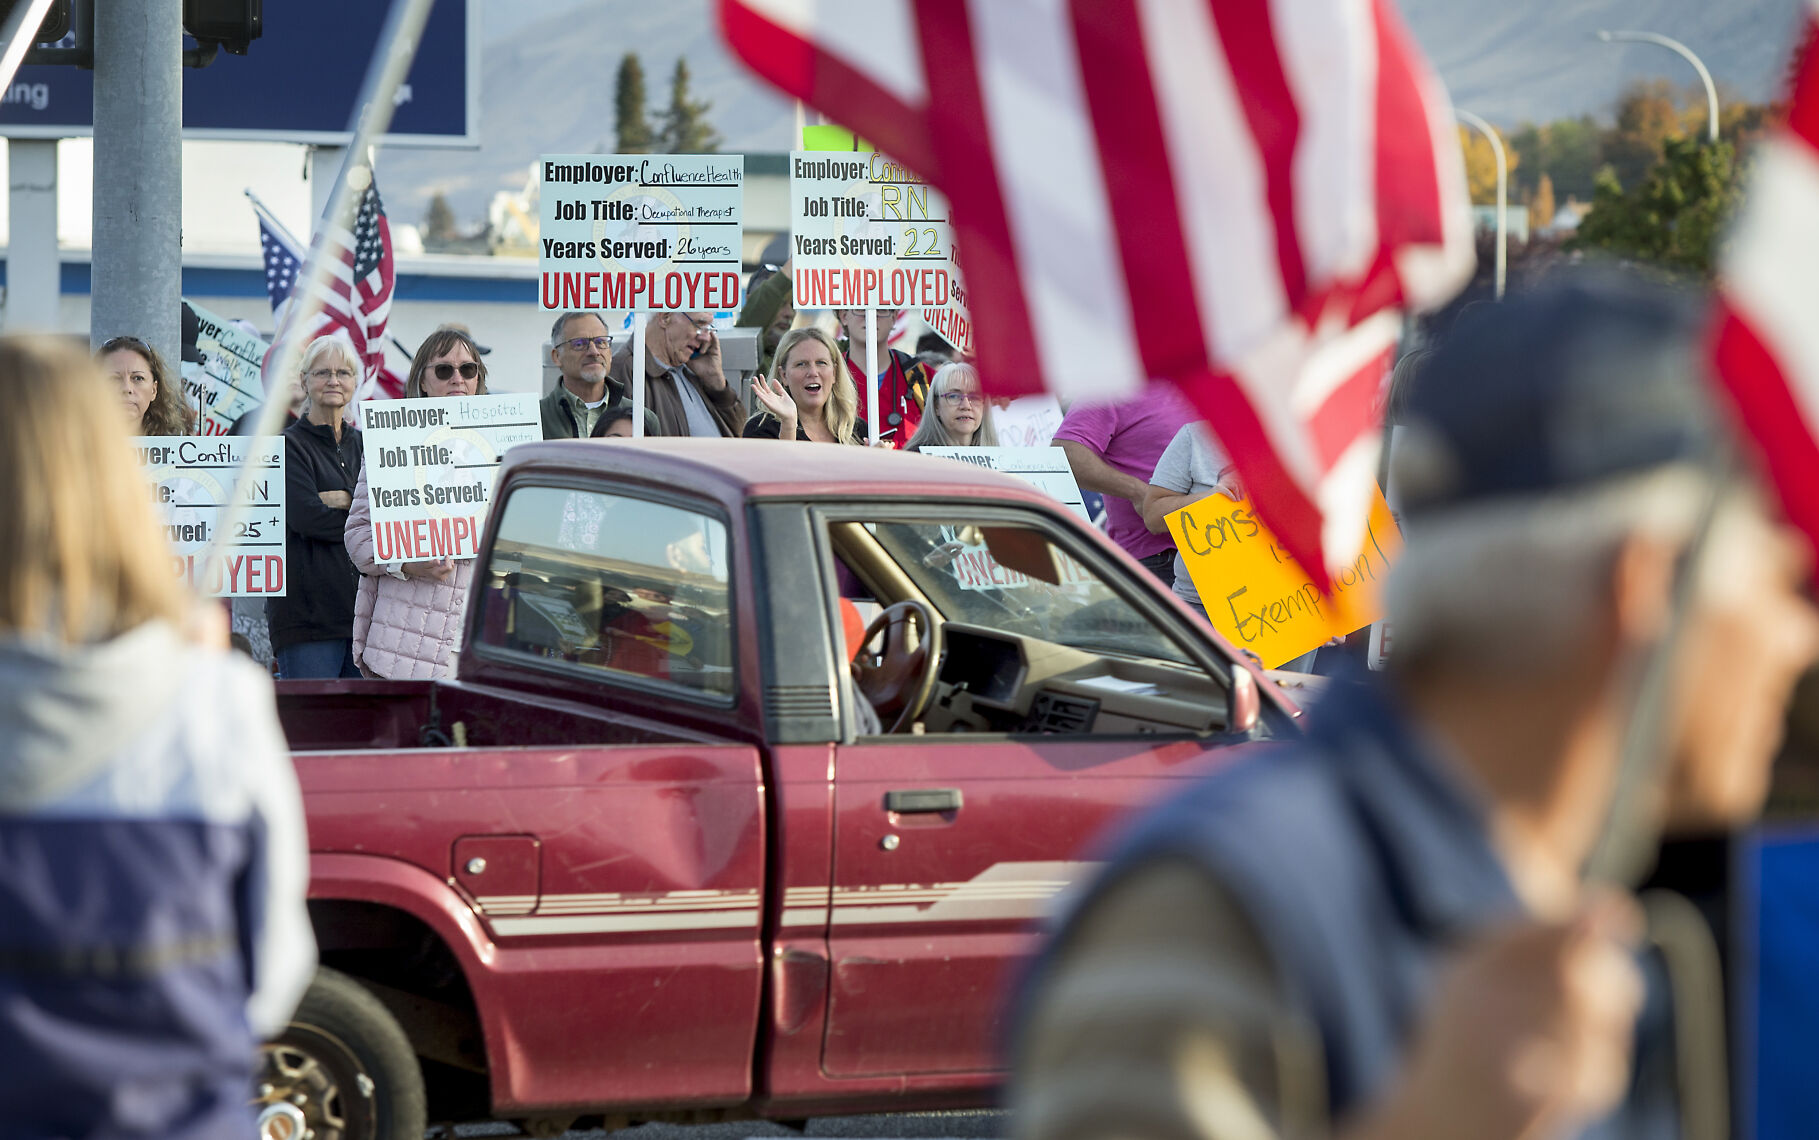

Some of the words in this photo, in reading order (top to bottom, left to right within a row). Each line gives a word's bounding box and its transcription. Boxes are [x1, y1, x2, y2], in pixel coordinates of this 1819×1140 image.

[545, 161, 639, 185] Employer:
[794, 158, 869, 181] Employer:
[554, 200, 587, 221] Job
[591, 200, 639, 221] Title:
[642, 203, 694, 221] Occupational
[697, 206, 735, 219] Therapist
[803, 196, 829, 217] Job
[831, 197, 869, 218] Title:
[881, 185, 929, 220] RN
[542, 238, 596, 259] Years
[600, 238, 672, 259] Served:
[794, 235, 837, 255] Years
[840, 235, 897, 256] Served:
[904, 228, 941, 256] 22
[542, 271, 740, 309] UNEMPLOYED
[795, 268, 949, 306] UNEMPLOYED
[365, 406, 450, 430] Employer:
[459, 401, 524, 420] Hospital
[379, 446, 408, 468] Job
[410, 445, 454, 467] Title:
[372, 485, 420, 509] Years
[423, 481, 488, 506] Served:
